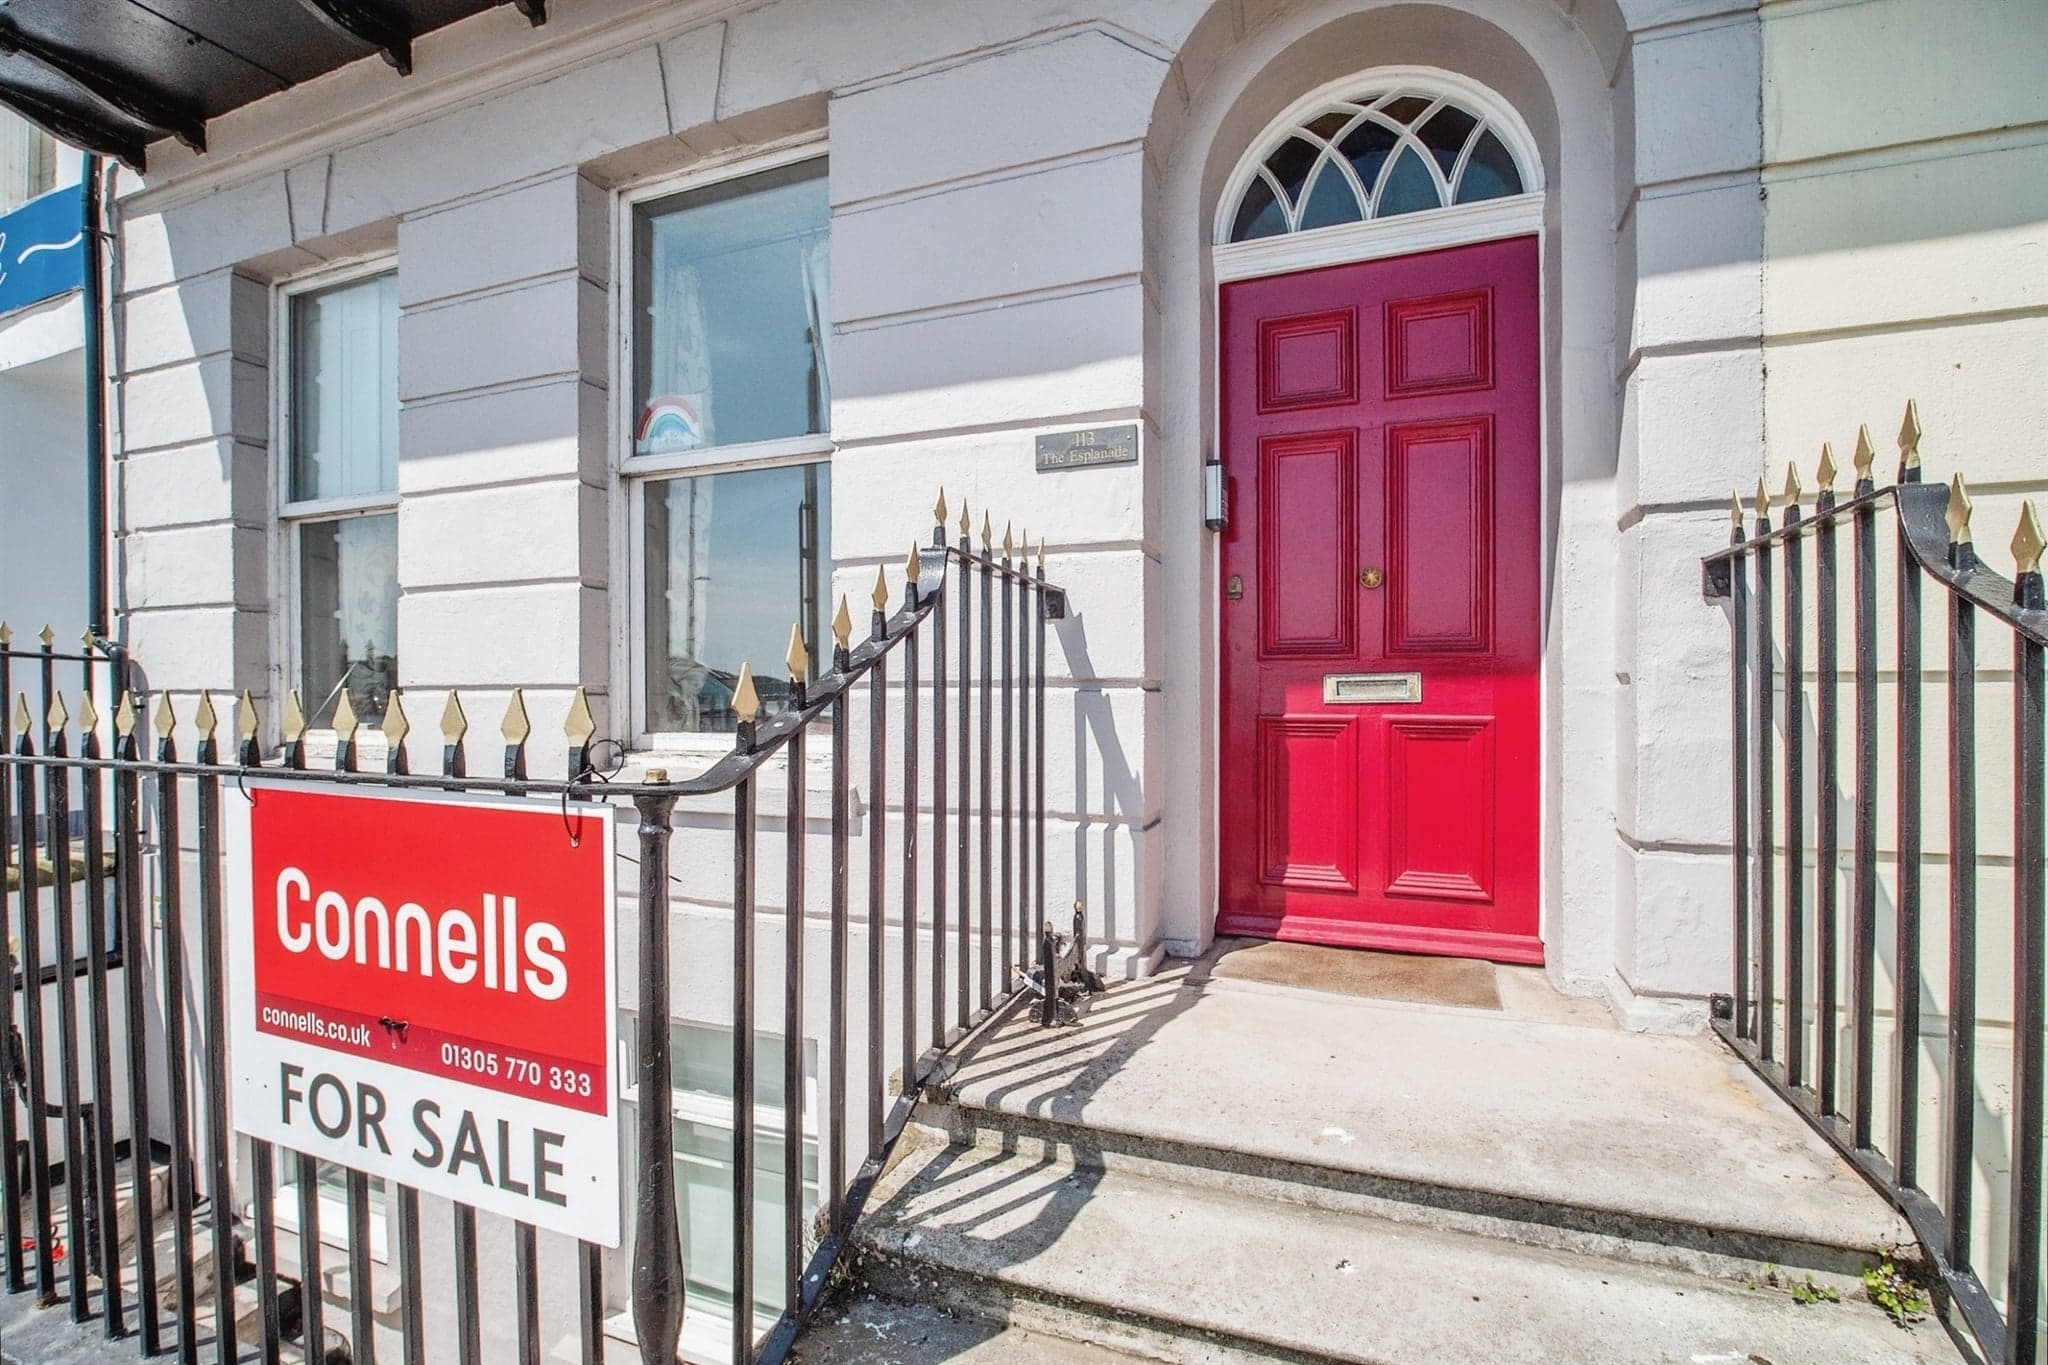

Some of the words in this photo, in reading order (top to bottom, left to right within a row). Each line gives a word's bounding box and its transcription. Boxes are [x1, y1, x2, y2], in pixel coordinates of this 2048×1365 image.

[1042, 452, 1064, 465] The
[1070, 446, 1129, 463] Esplanade
[1074, 431, 1095, 447] 113
[276, 867, 567, 1001] Connells
[262, 1006, 371, 1048] connells.co.uk
[441, 1042, 498, 1076] 01305
[504, 1056, 541, 1086] 770
[549, 1067, 592, 1097] 333
[280, 1062, 392, 1156] FOR
[412, 1098, 567, 1208] SALE
